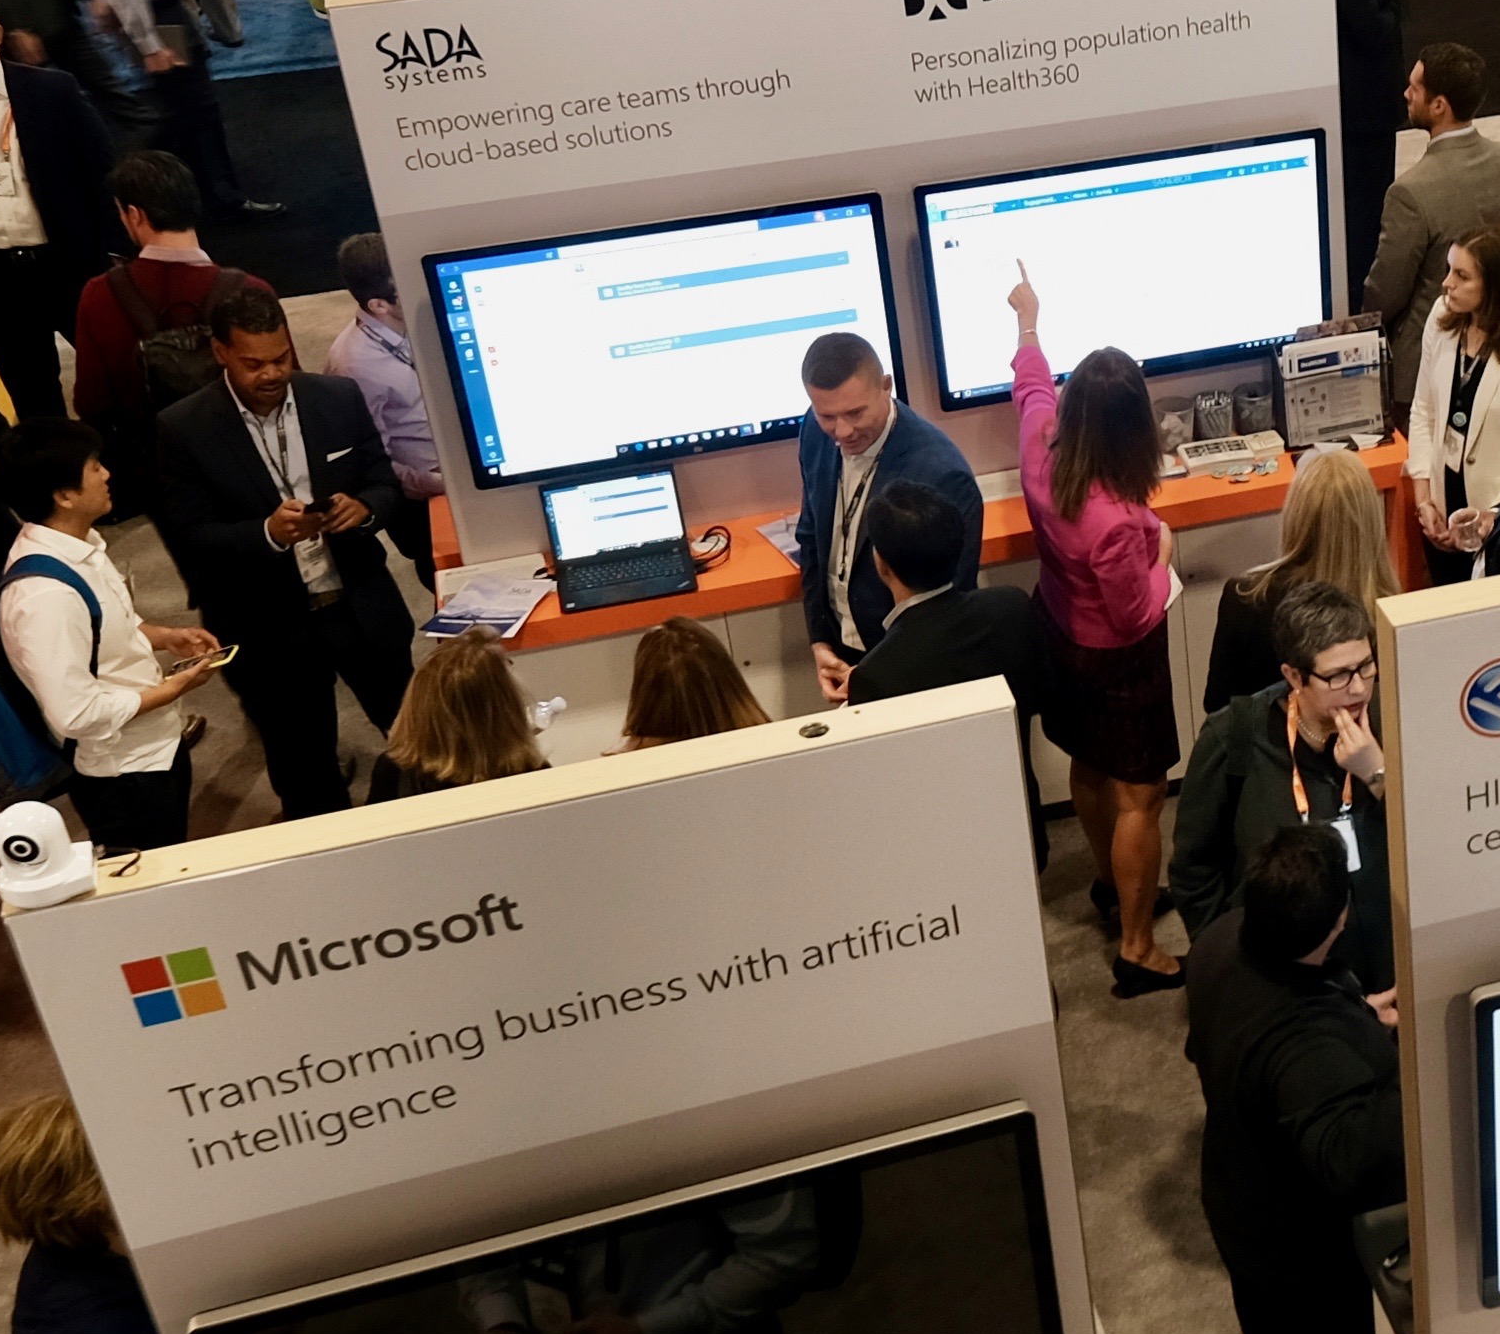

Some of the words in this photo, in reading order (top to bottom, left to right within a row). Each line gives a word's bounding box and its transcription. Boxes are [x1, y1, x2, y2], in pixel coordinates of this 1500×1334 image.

[375, 23, 484, 73] SADA
[910, 38, 1057, 72] Personalizing
[1063, 23, 1181, 59] population
[1185, 10, 1252, 37] health
[384, 64, 488, 93] systems
[396, 101, 555, 140] Empowering
[561, 95, 612, 118] care
[617, 83, 691, 109] teams
[696, 69, 791, 101] through
[236, 893, 524, 992] Microsoft
[168, 1018, 486, 1120] Transforming
[496, 972, 688, 1044] business
[698, 946, 790, 998] with
[801, 905, 962, 972] artificial
